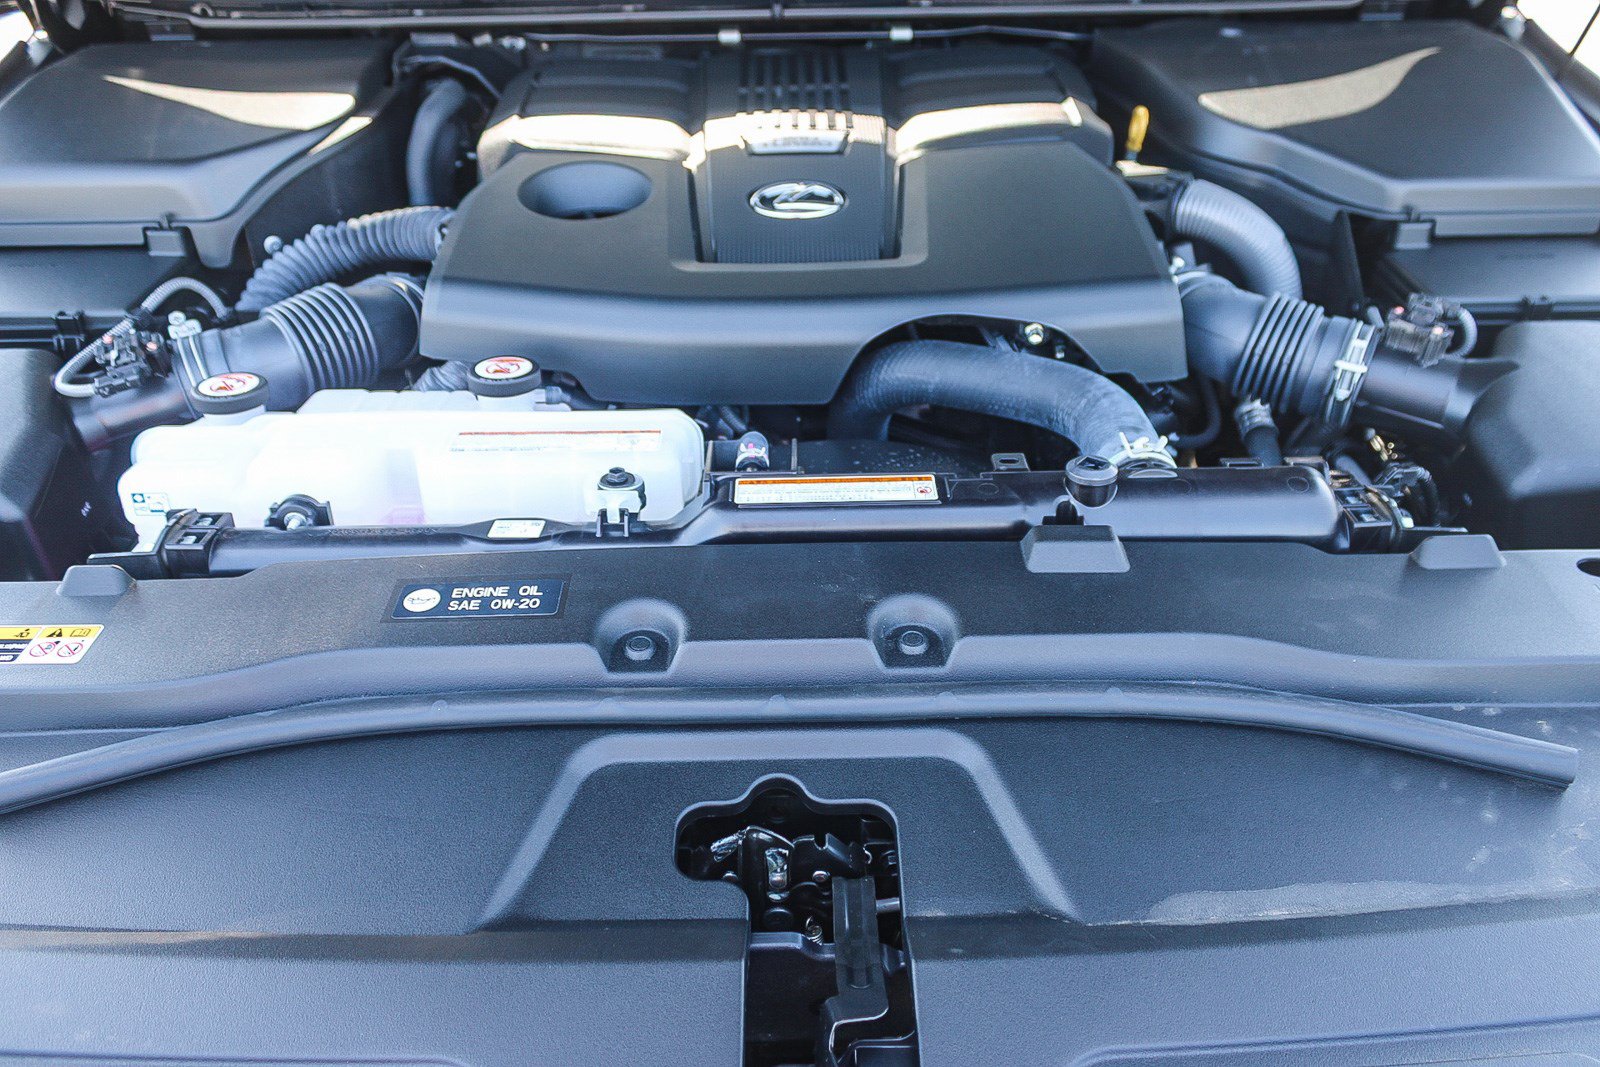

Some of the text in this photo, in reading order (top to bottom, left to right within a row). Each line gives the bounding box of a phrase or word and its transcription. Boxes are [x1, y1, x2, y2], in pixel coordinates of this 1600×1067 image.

[451, 585, 543, 598] ENGINE OIL
[448, 598, 541, 610] SAE 0W-20
